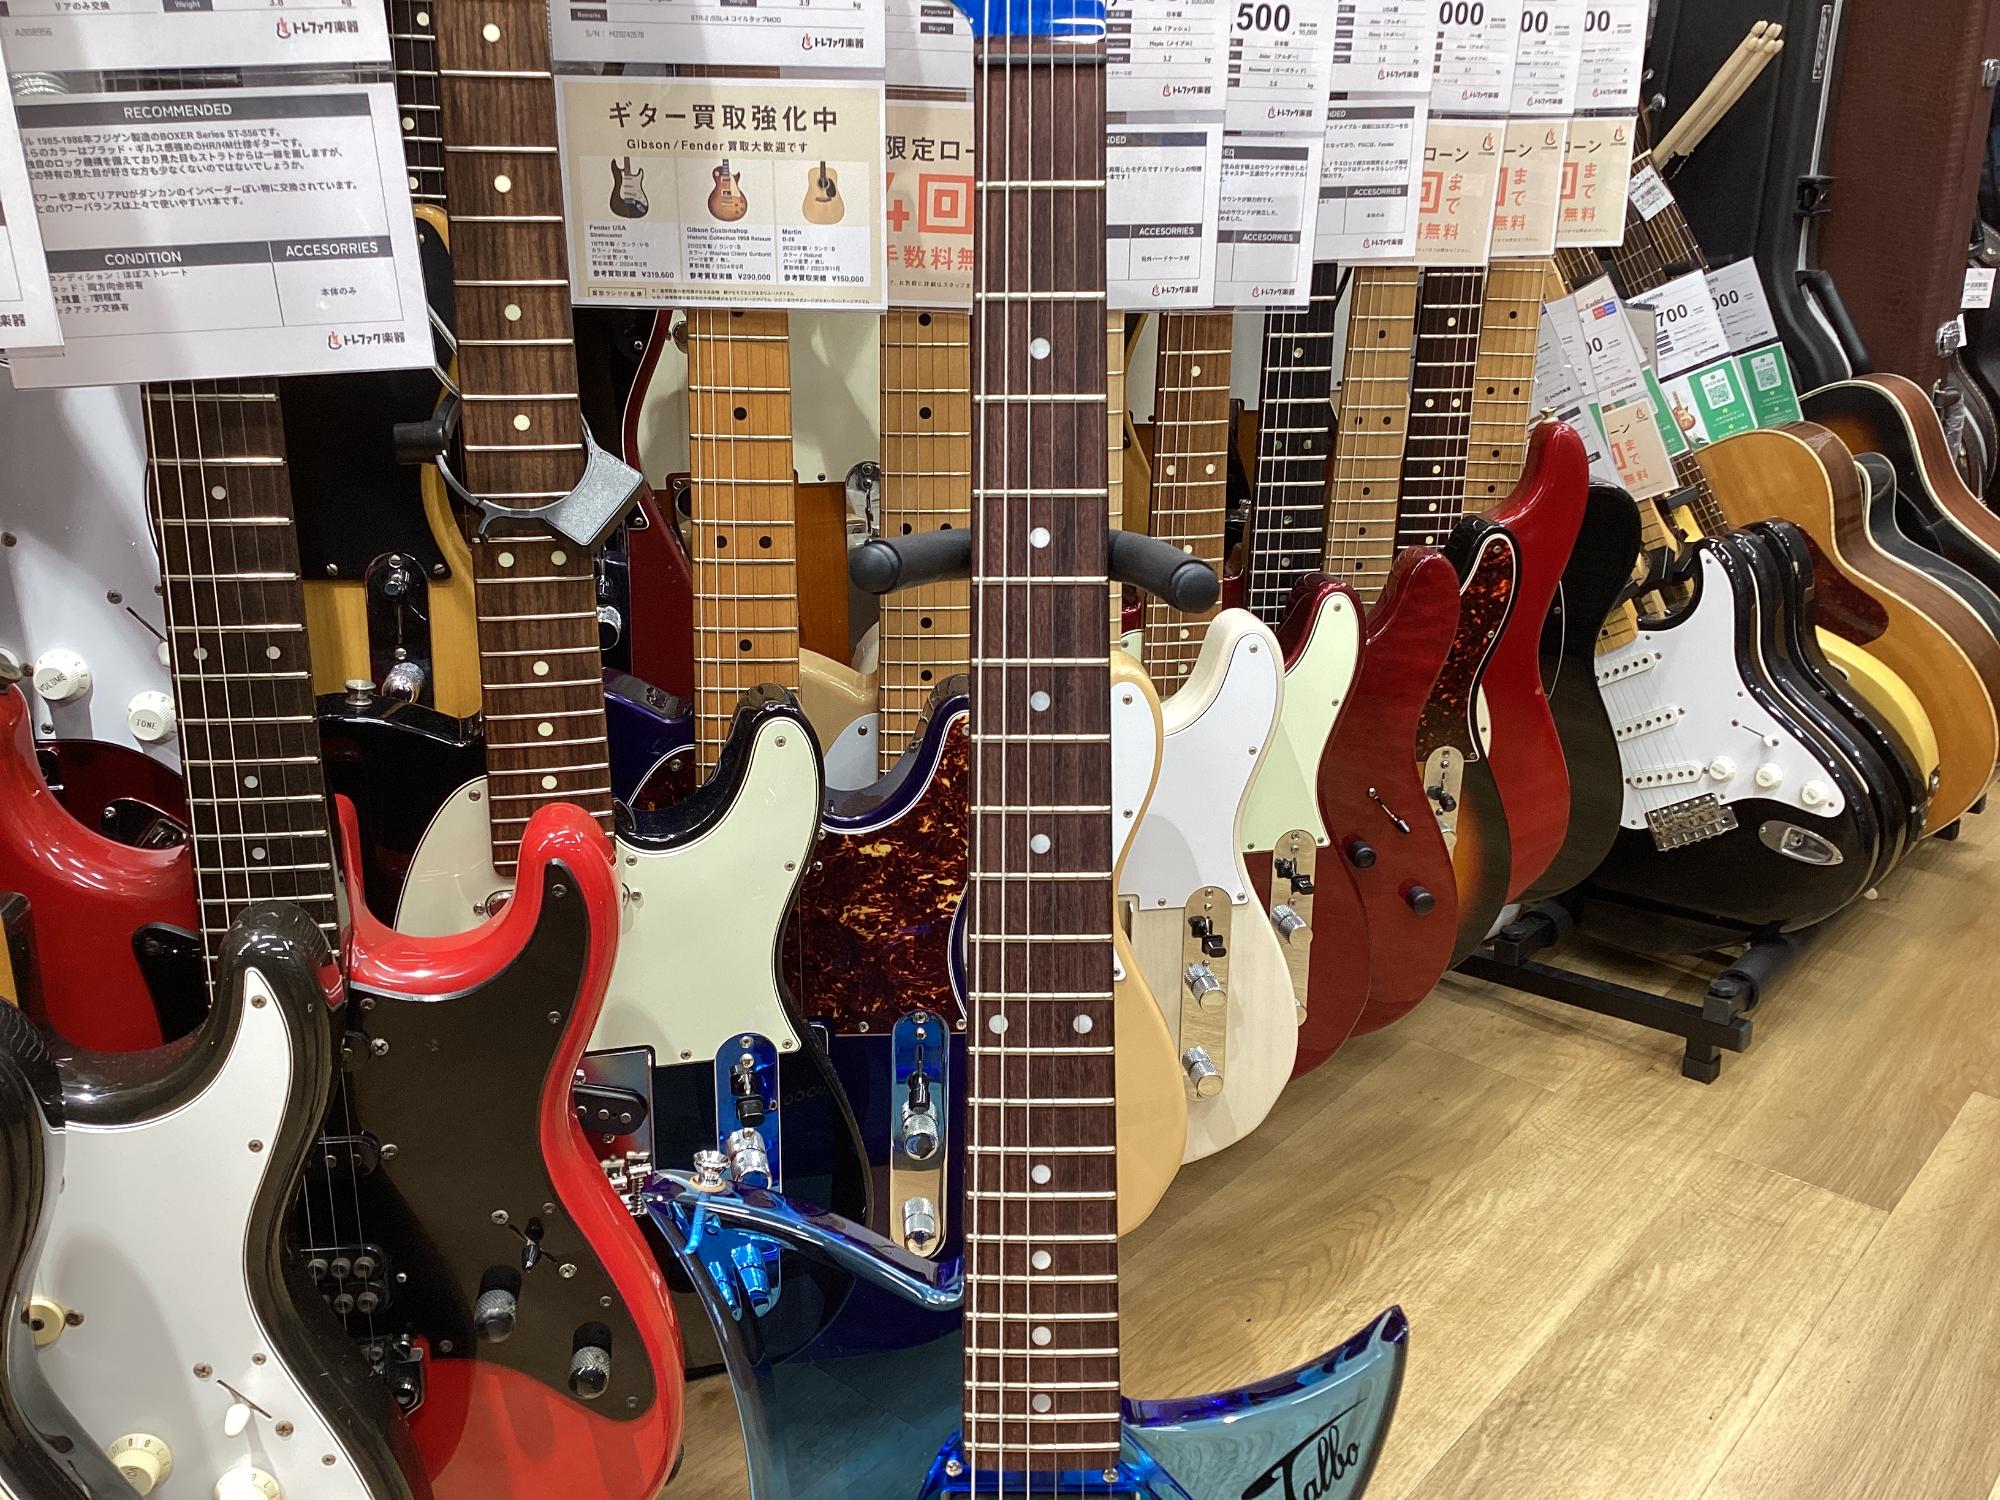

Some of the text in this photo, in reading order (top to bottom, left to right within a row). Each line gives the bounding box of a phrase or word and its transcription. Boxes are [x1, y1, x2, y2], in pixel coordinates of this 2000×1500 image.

[55, 1, 110, 11] リアのみ交換
[1440, 1, 1484, 25] 000
[293, 20, 358, 34] トレファク楽器
[815, 38, 864, 49] トレファク楽器
[1173, 86, 1211, 94] トレファク楽器
[123, 103, 232, 120] RECOMMENDED
[609, 101, 838, 132] ギター買取強化中
[196, 130, 225, 139] Series
[627, 139, 670, 150] Gibson
[681, 140, 724, 151] Fender
[728, 141, 808, 153] 買取大歓迎です
[1424, 147, 1469, 162] ローン
[1512, 168, 1527, 206] まで
[1582, 162, 1597, 199] まで
[1353, 188, 1401, 196] ACCESORRIES
[1446, 173, 1463, 214] まで
[710, 227, 748, 235] Customshop
[1139, 227, 1194, 236] ACCESORRIES
[1242, 233, 1294, 241] ACCESORRIES
[285, 242, 378, 257] ACCESORRIES
[104, 251, 182, 266] CONDITION
[641, 271, 675, 279] ¥319,600
[832, 275, 865, 283] ¥150,000
[321, 286, 357, 297] 本体のみ
[1161, 285, 1198, 294] トレファク楽器
[1656, 304, 1688, 327] 700
[343, 331, 406, 345] トレファク楽器
[37, 672, 67, 692] VOLUME
[136, 718, 157, 730] TONE
[1241, 1397, 1369, 1500] Talbo
